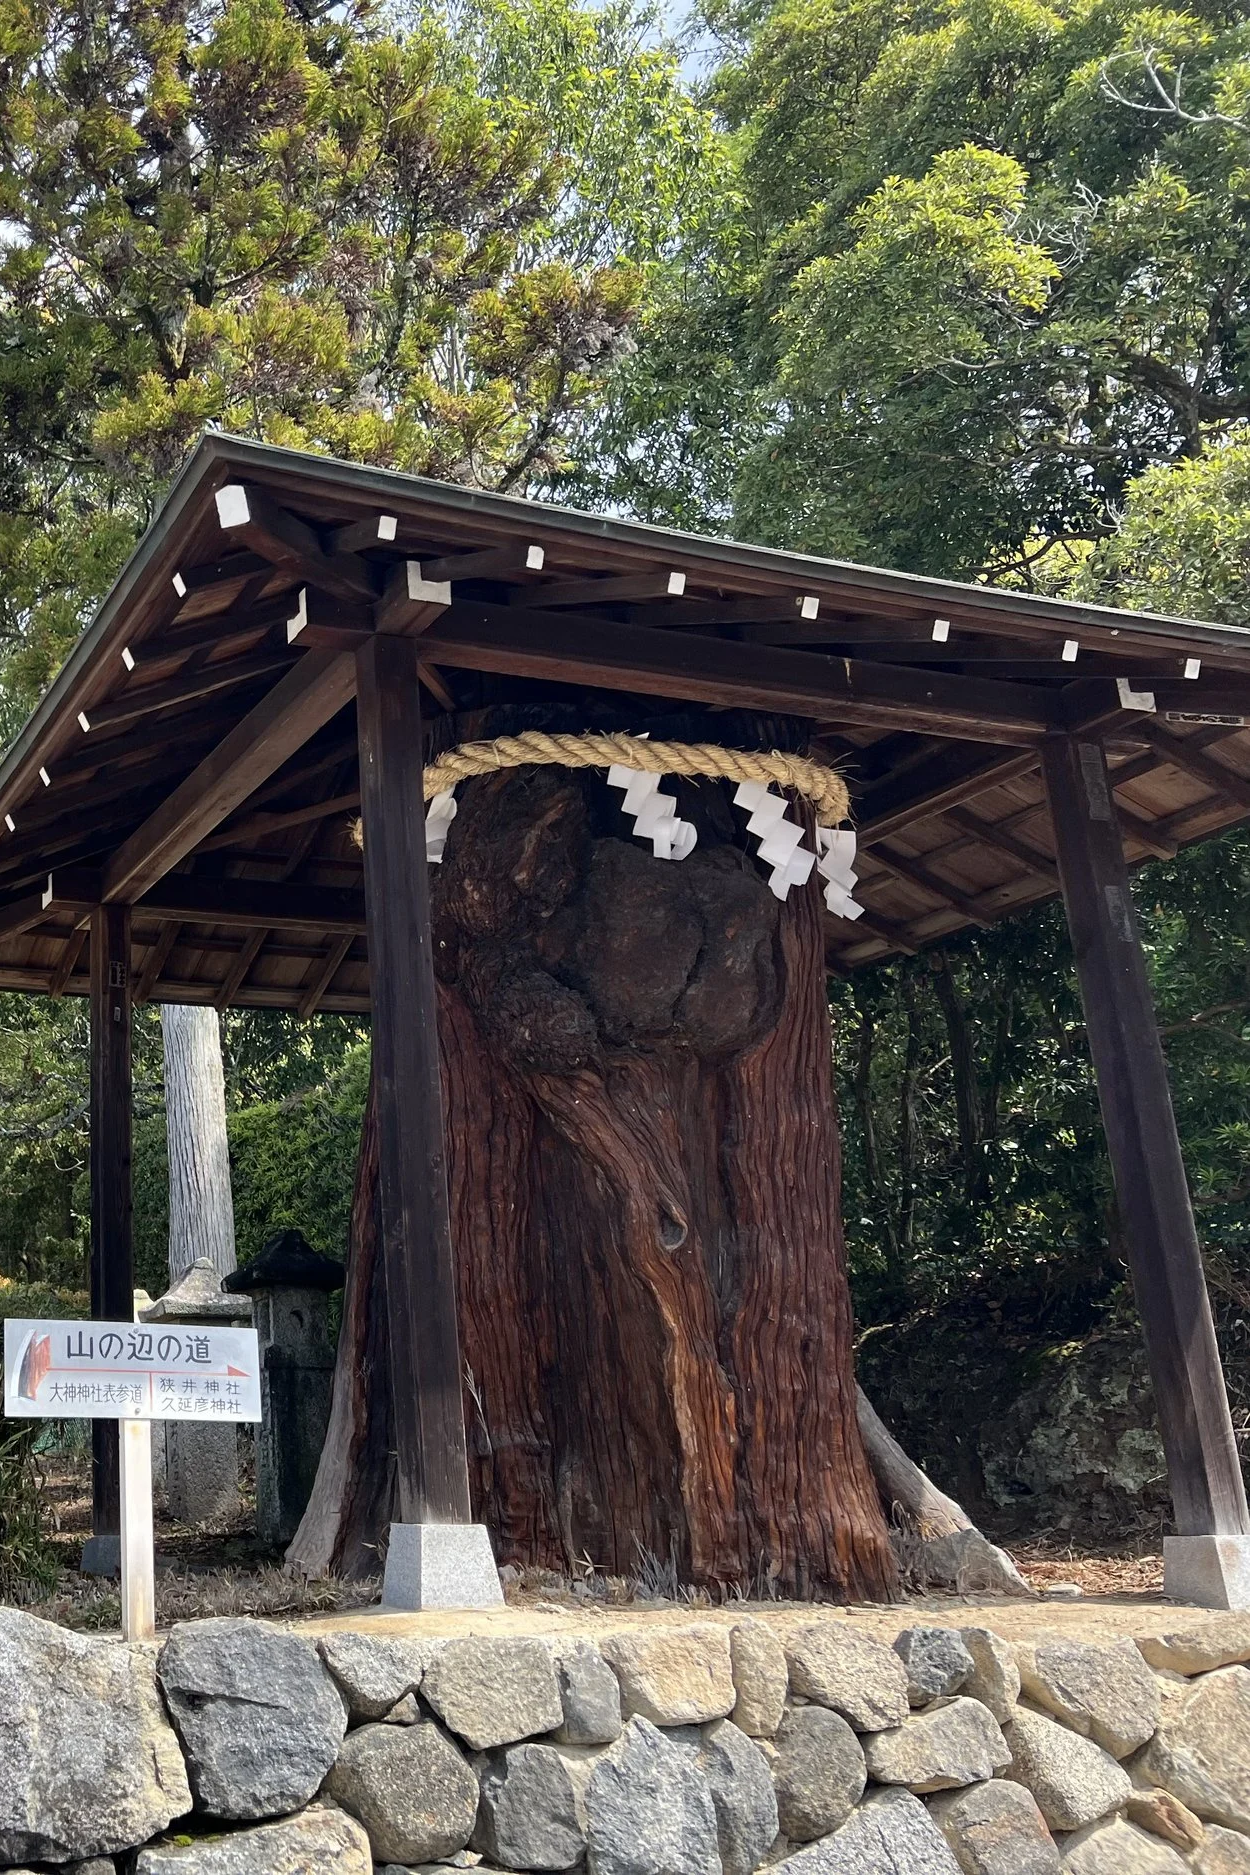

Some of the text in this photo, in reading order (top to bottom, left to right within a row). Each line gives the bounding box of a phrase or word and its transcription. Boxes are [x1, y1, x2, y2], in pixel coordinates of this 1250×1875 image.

[67, 1331, 212, 1364] 山の辺の道
[50, 1382, 143, 1404] 大神神社表参道
[160, 1378, 242, 1395] 狭井神社
[161, 1397, 243, 1415] 久延彦神社
